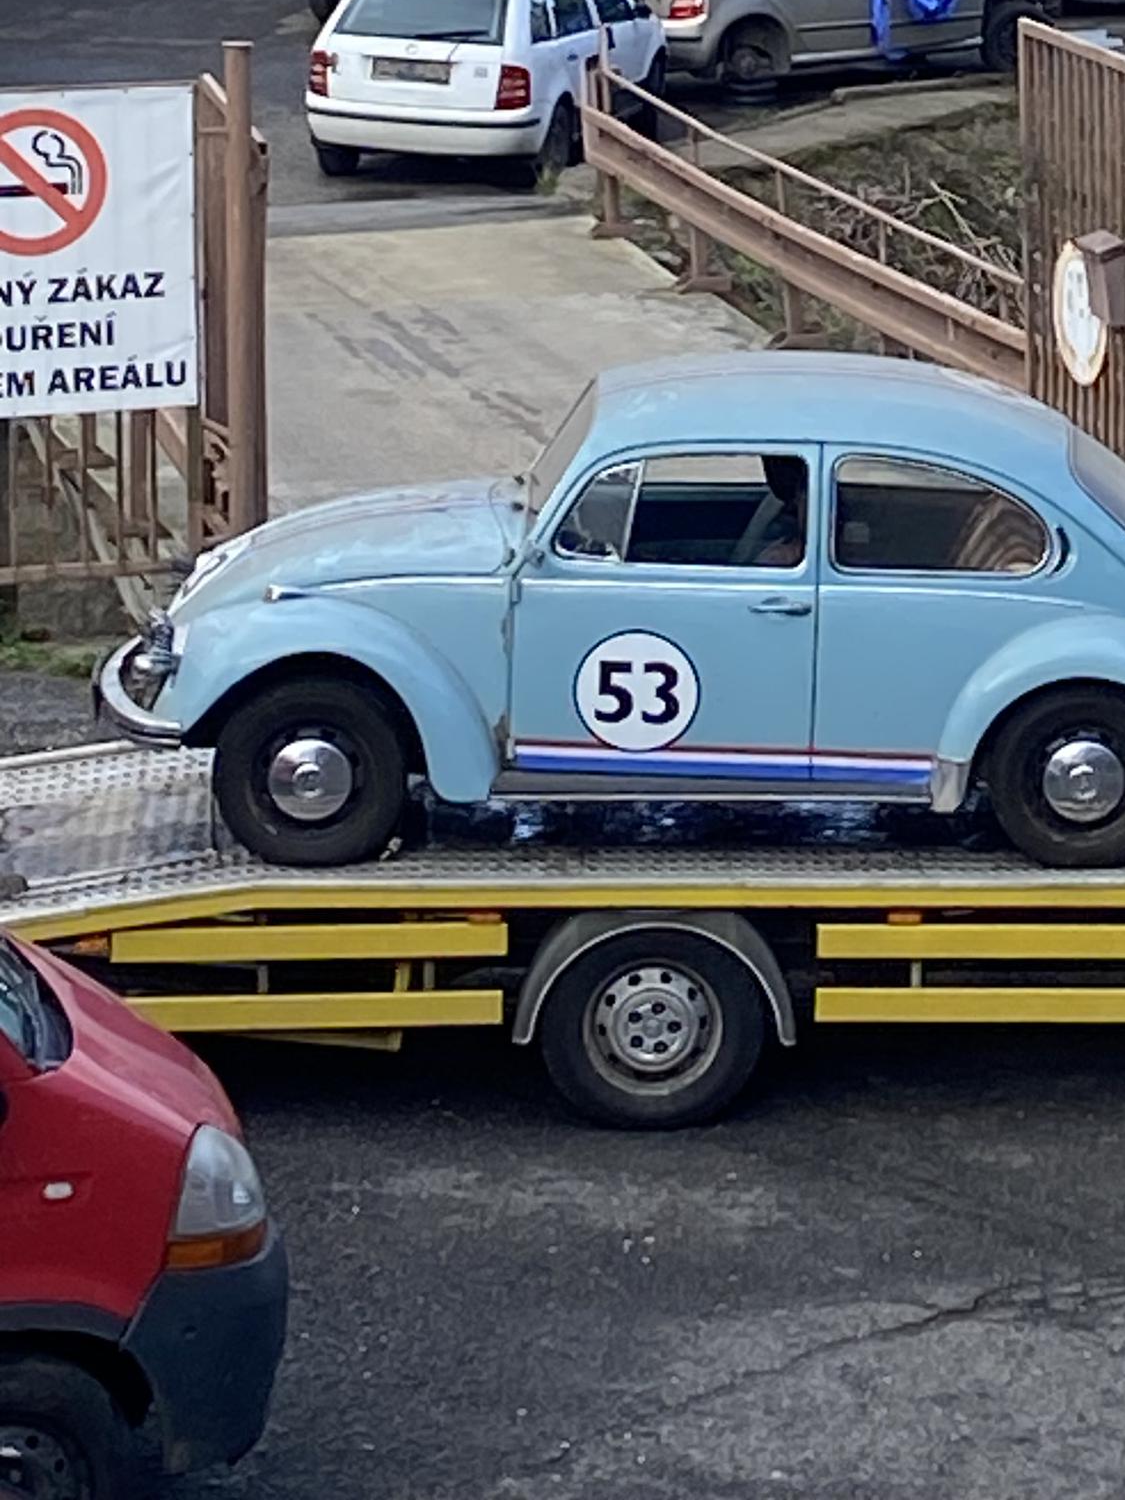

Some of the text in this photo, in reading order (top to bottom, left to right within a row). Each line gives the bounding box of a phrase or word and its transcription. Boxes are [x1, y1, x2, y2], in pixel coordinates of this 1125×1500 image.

[48, 267, 166, 304] ZÁKAZ
[0, 311, 116, 352] UŘENÍ
[0, 354, 188, 398] M AREÁLU
[594, 660, 680, 725] 53
